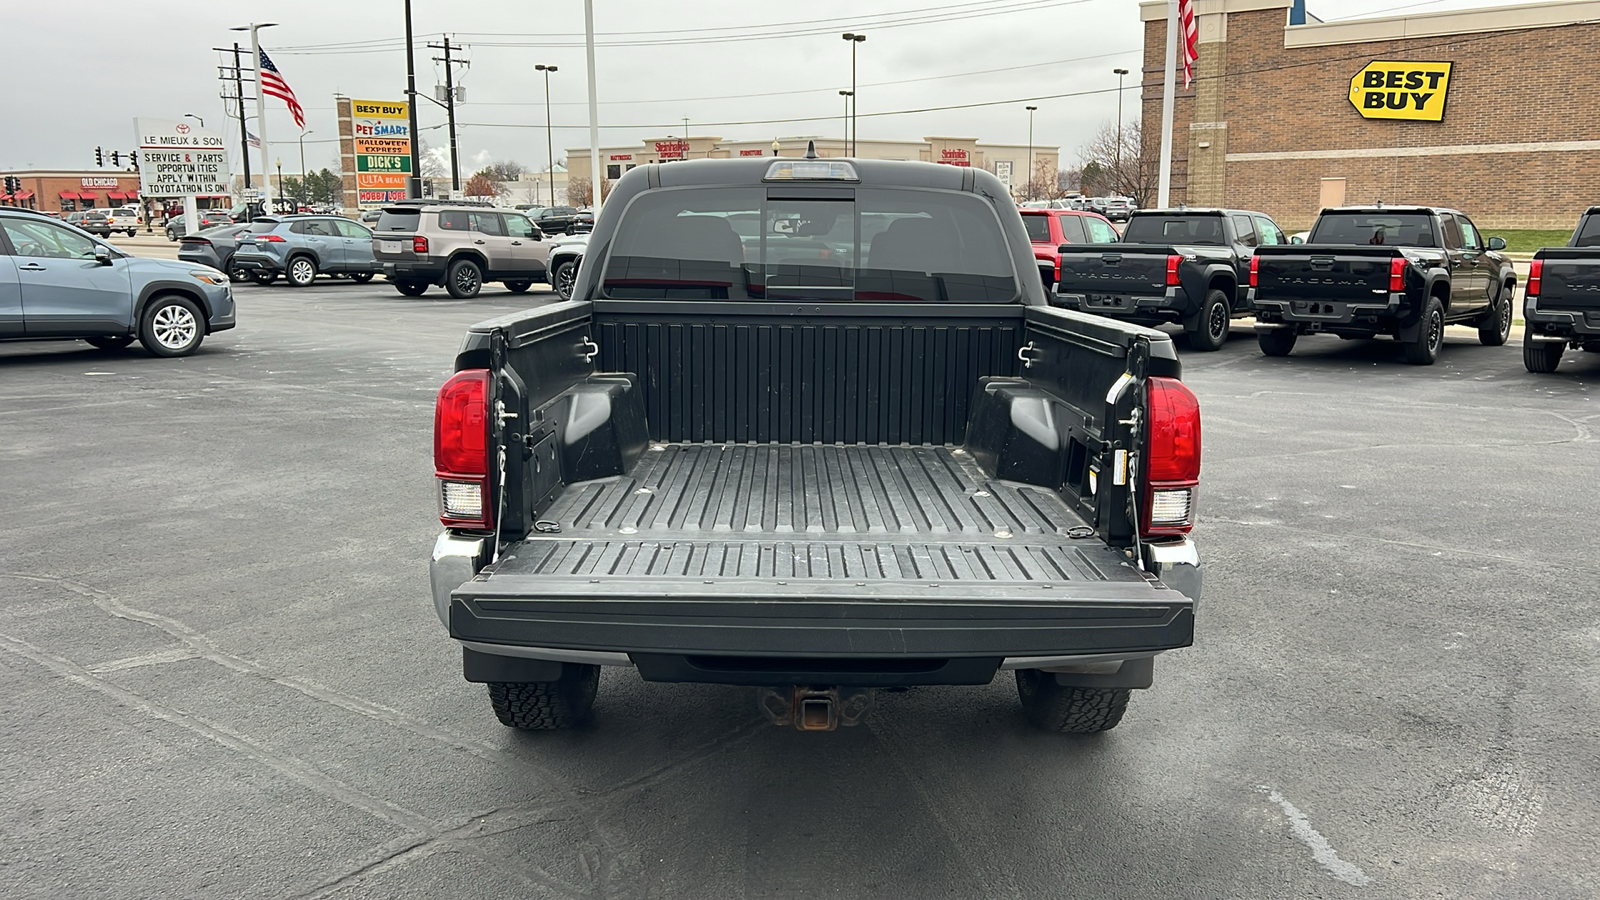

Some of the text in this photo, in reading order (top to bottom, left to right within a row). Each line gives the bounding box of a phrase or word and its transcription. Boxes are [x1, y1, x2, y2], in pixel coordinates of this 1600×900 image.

[1363, 71, 1445, 90] BEST
[1363, 92, 1434, 110] BUY
[356, 105, 381, 114] BEST
[356, 124, 407, 135] PETSMART
[144, 136, 156, 144] LE
[160, 137, 189, 145] MIEUX
[145, 154, 223, 162] SERVICE & PARTS
[367, 156, 401, 168] DICK'S
[82, 178, 117, 187] OLD CHICAGO
[157, 174, 216, 182] APPLY WITHIN
[361, 175, 383, 184] ULTA
[149, 185, 202, 193] TOYOTATHON
[215, 184, 227, 192] ON!
[361, 191, 406, 201] HOBBY LOBB
[1278, 277, 1367, 285] TACOMA
